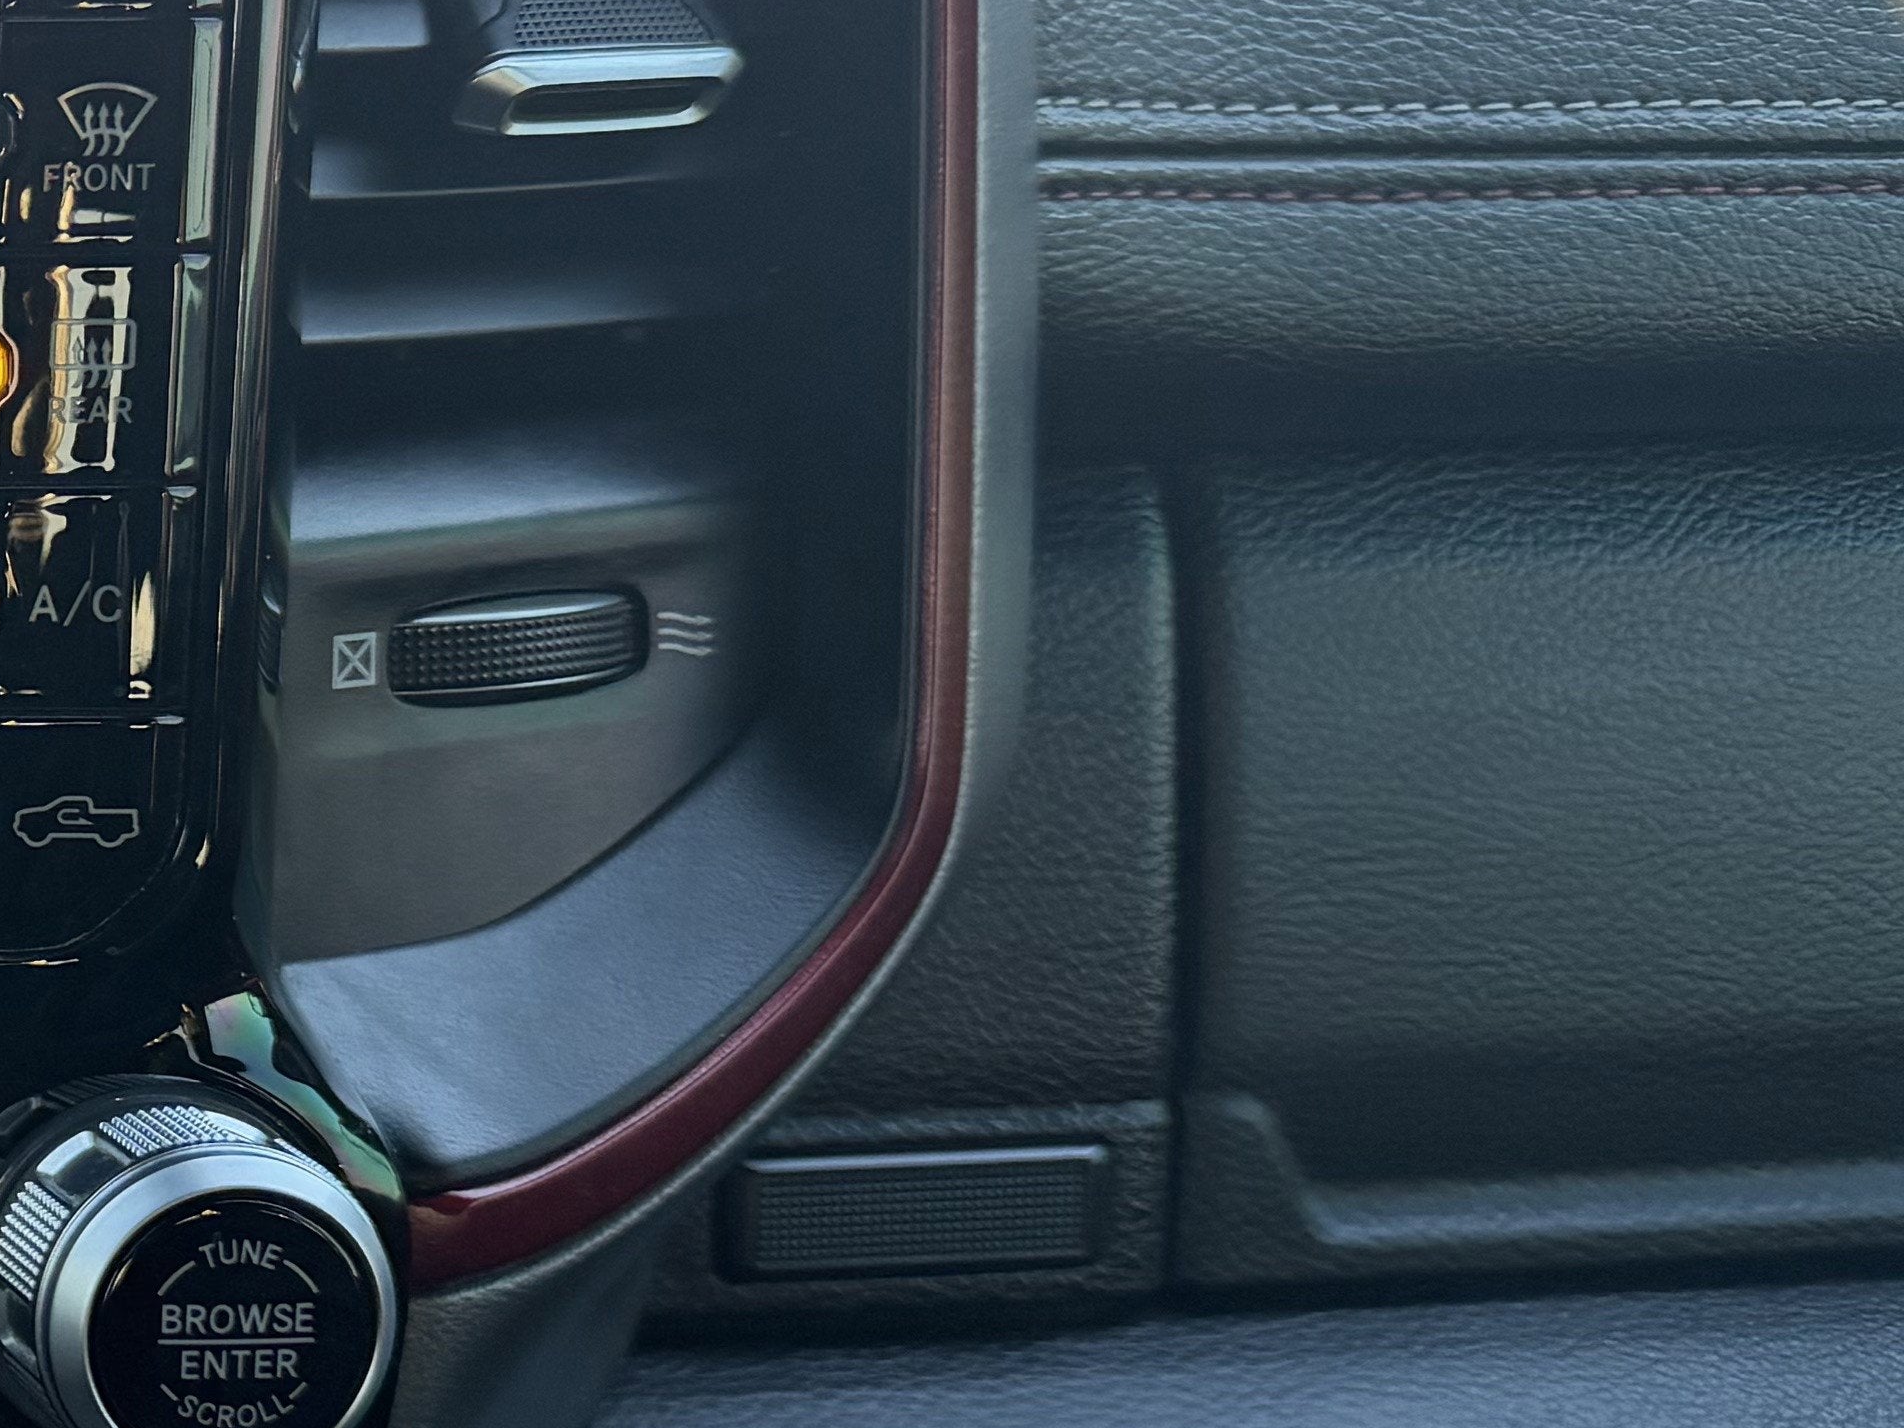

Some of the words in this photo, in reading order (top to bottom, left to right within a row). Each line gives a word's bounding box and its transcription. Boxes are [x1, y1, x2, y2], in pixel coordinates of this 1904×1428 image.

[42, 162, 156, 193] FRONT
[49, 396, 133, 425] REAR
[28, 584, 123, 624] A/C
[199, 1238, 285, 1270] TUNE
[161, 1302, 314, 1335] BROWSE
[180, 1348, 298, 1380] ENTER
[177, 1394, 296, 1428] SCROLL
